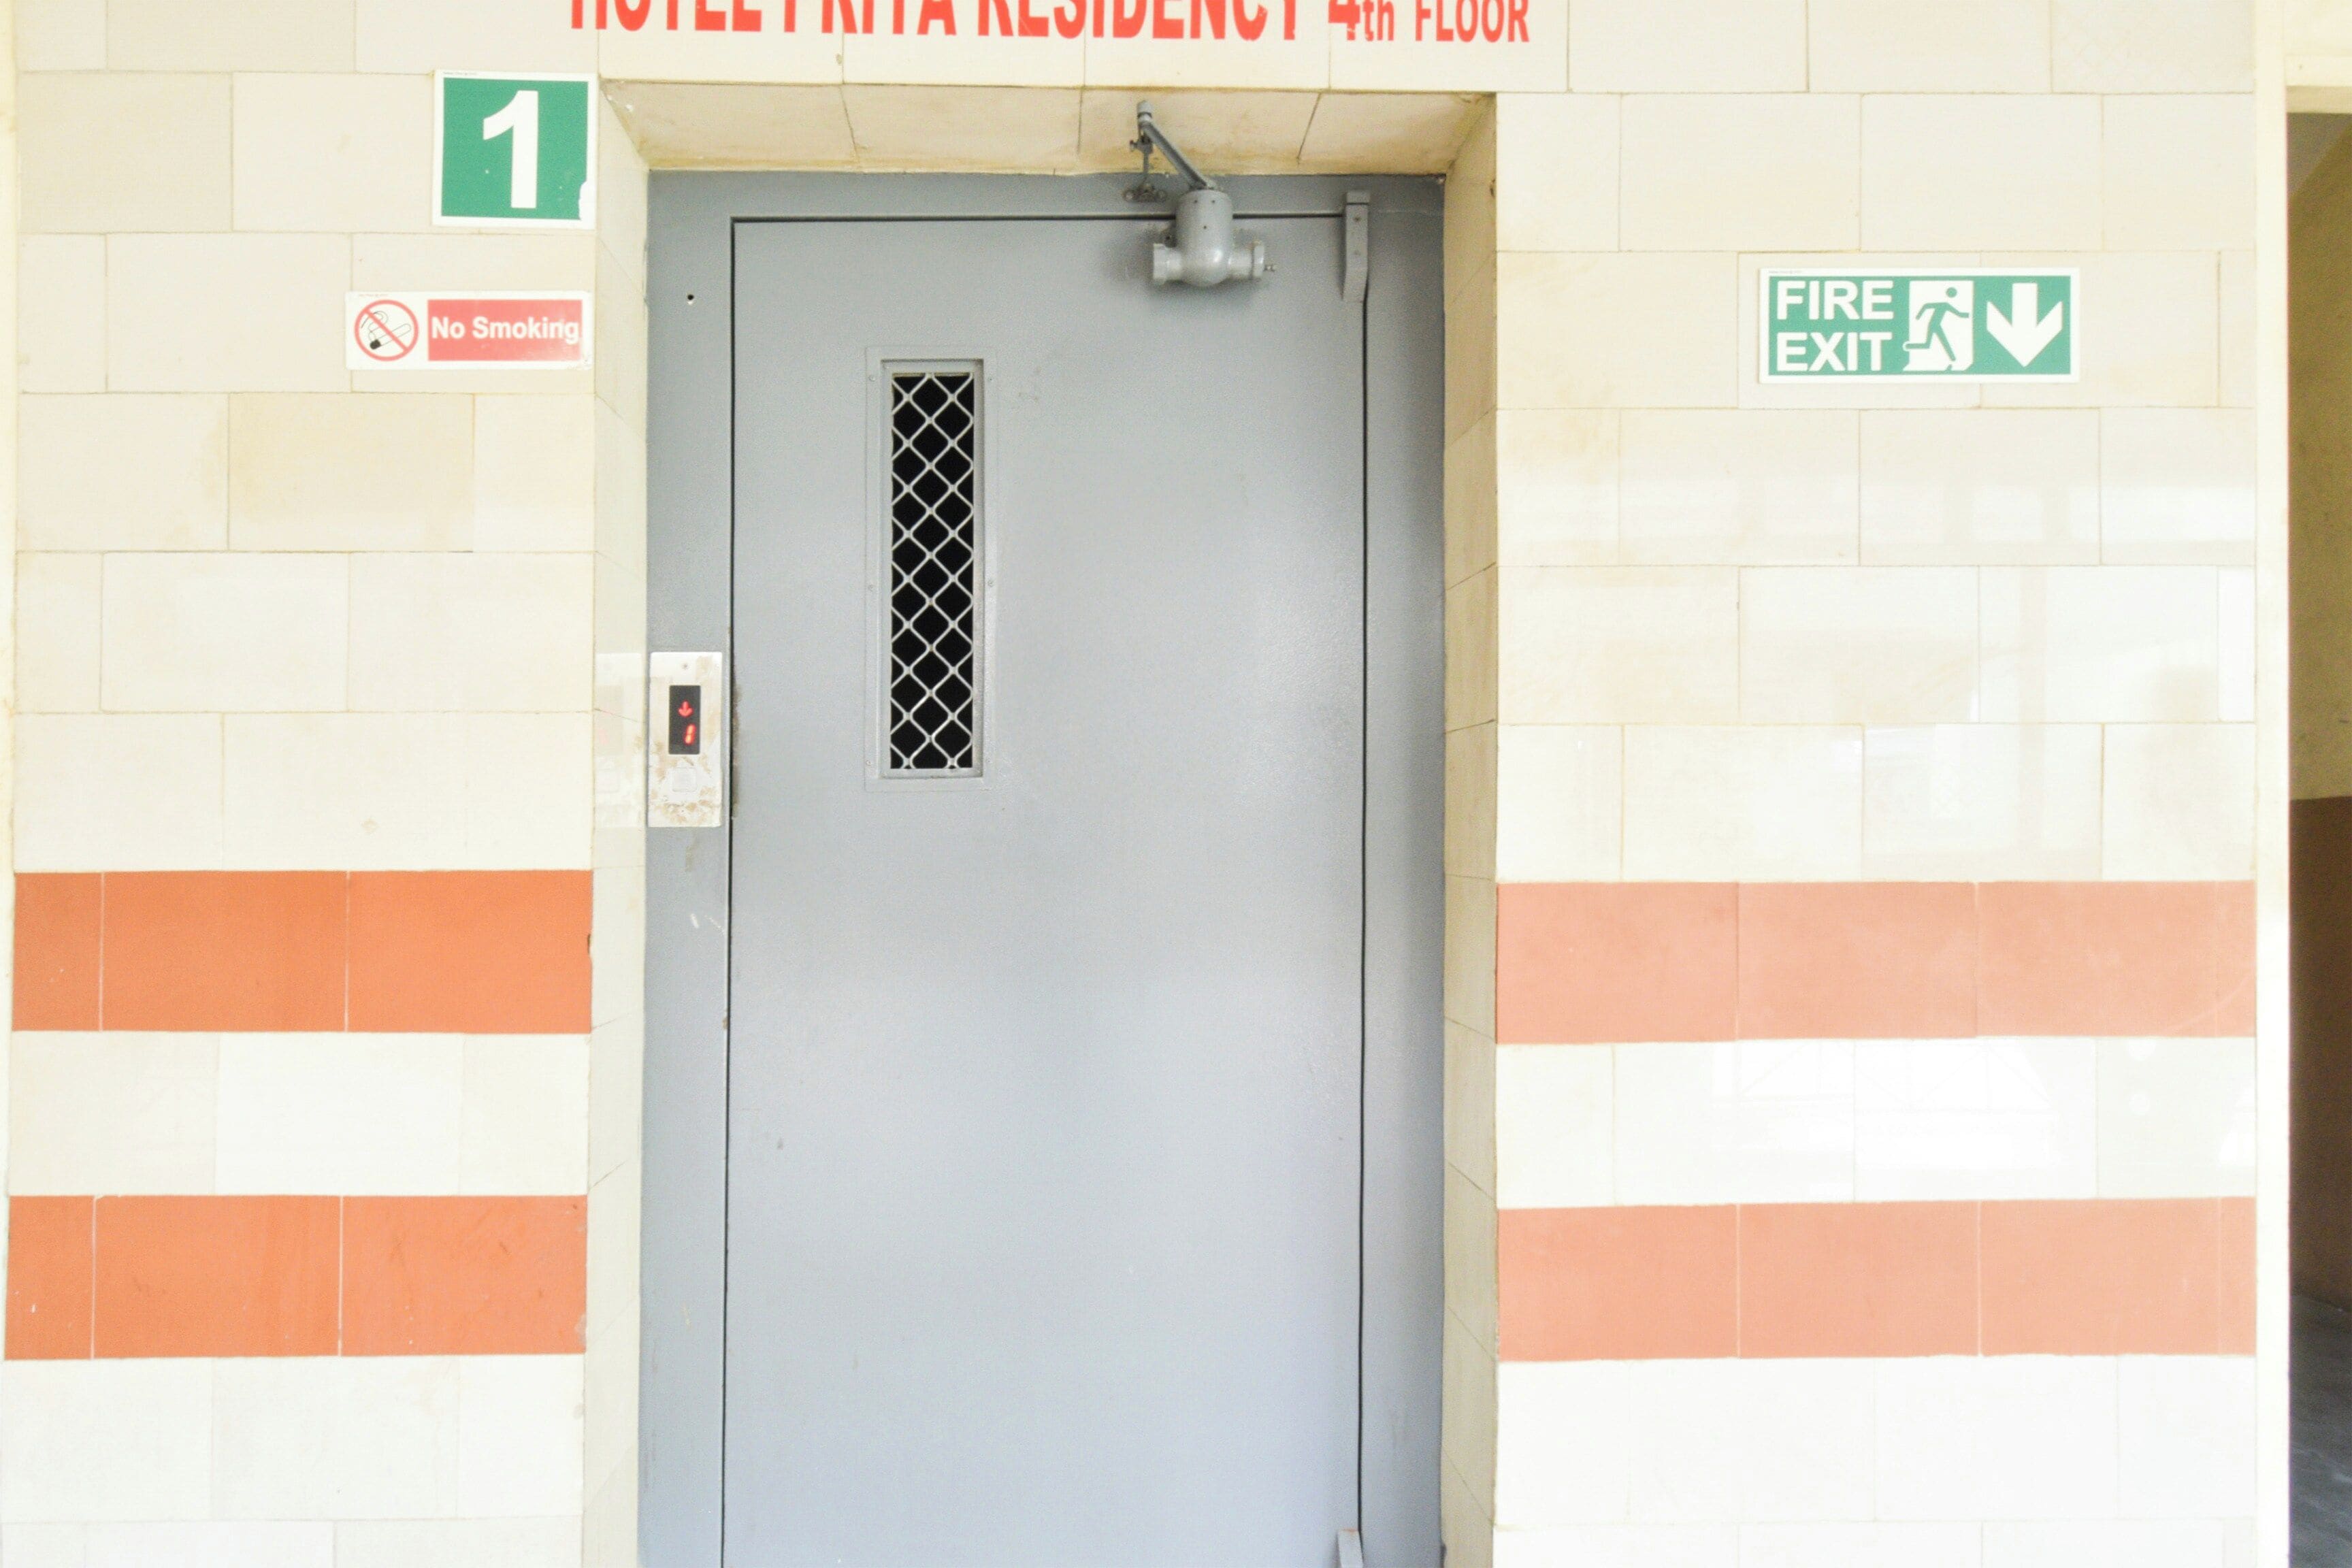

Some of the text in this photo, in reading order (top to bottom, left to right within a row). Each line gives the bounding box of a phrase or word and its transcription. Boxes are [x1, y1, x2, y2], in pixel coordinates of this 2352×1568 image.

[1415, 0, 1529, 42] FLOOR
[483, 90, 538, 209] 1
[1777, 280, 1894, 320] FIRE
[431, 316, 580, 345] No Smoking
[1776, 331, 1893, 372] EXIT
[684, 723, 696, 745] 1
